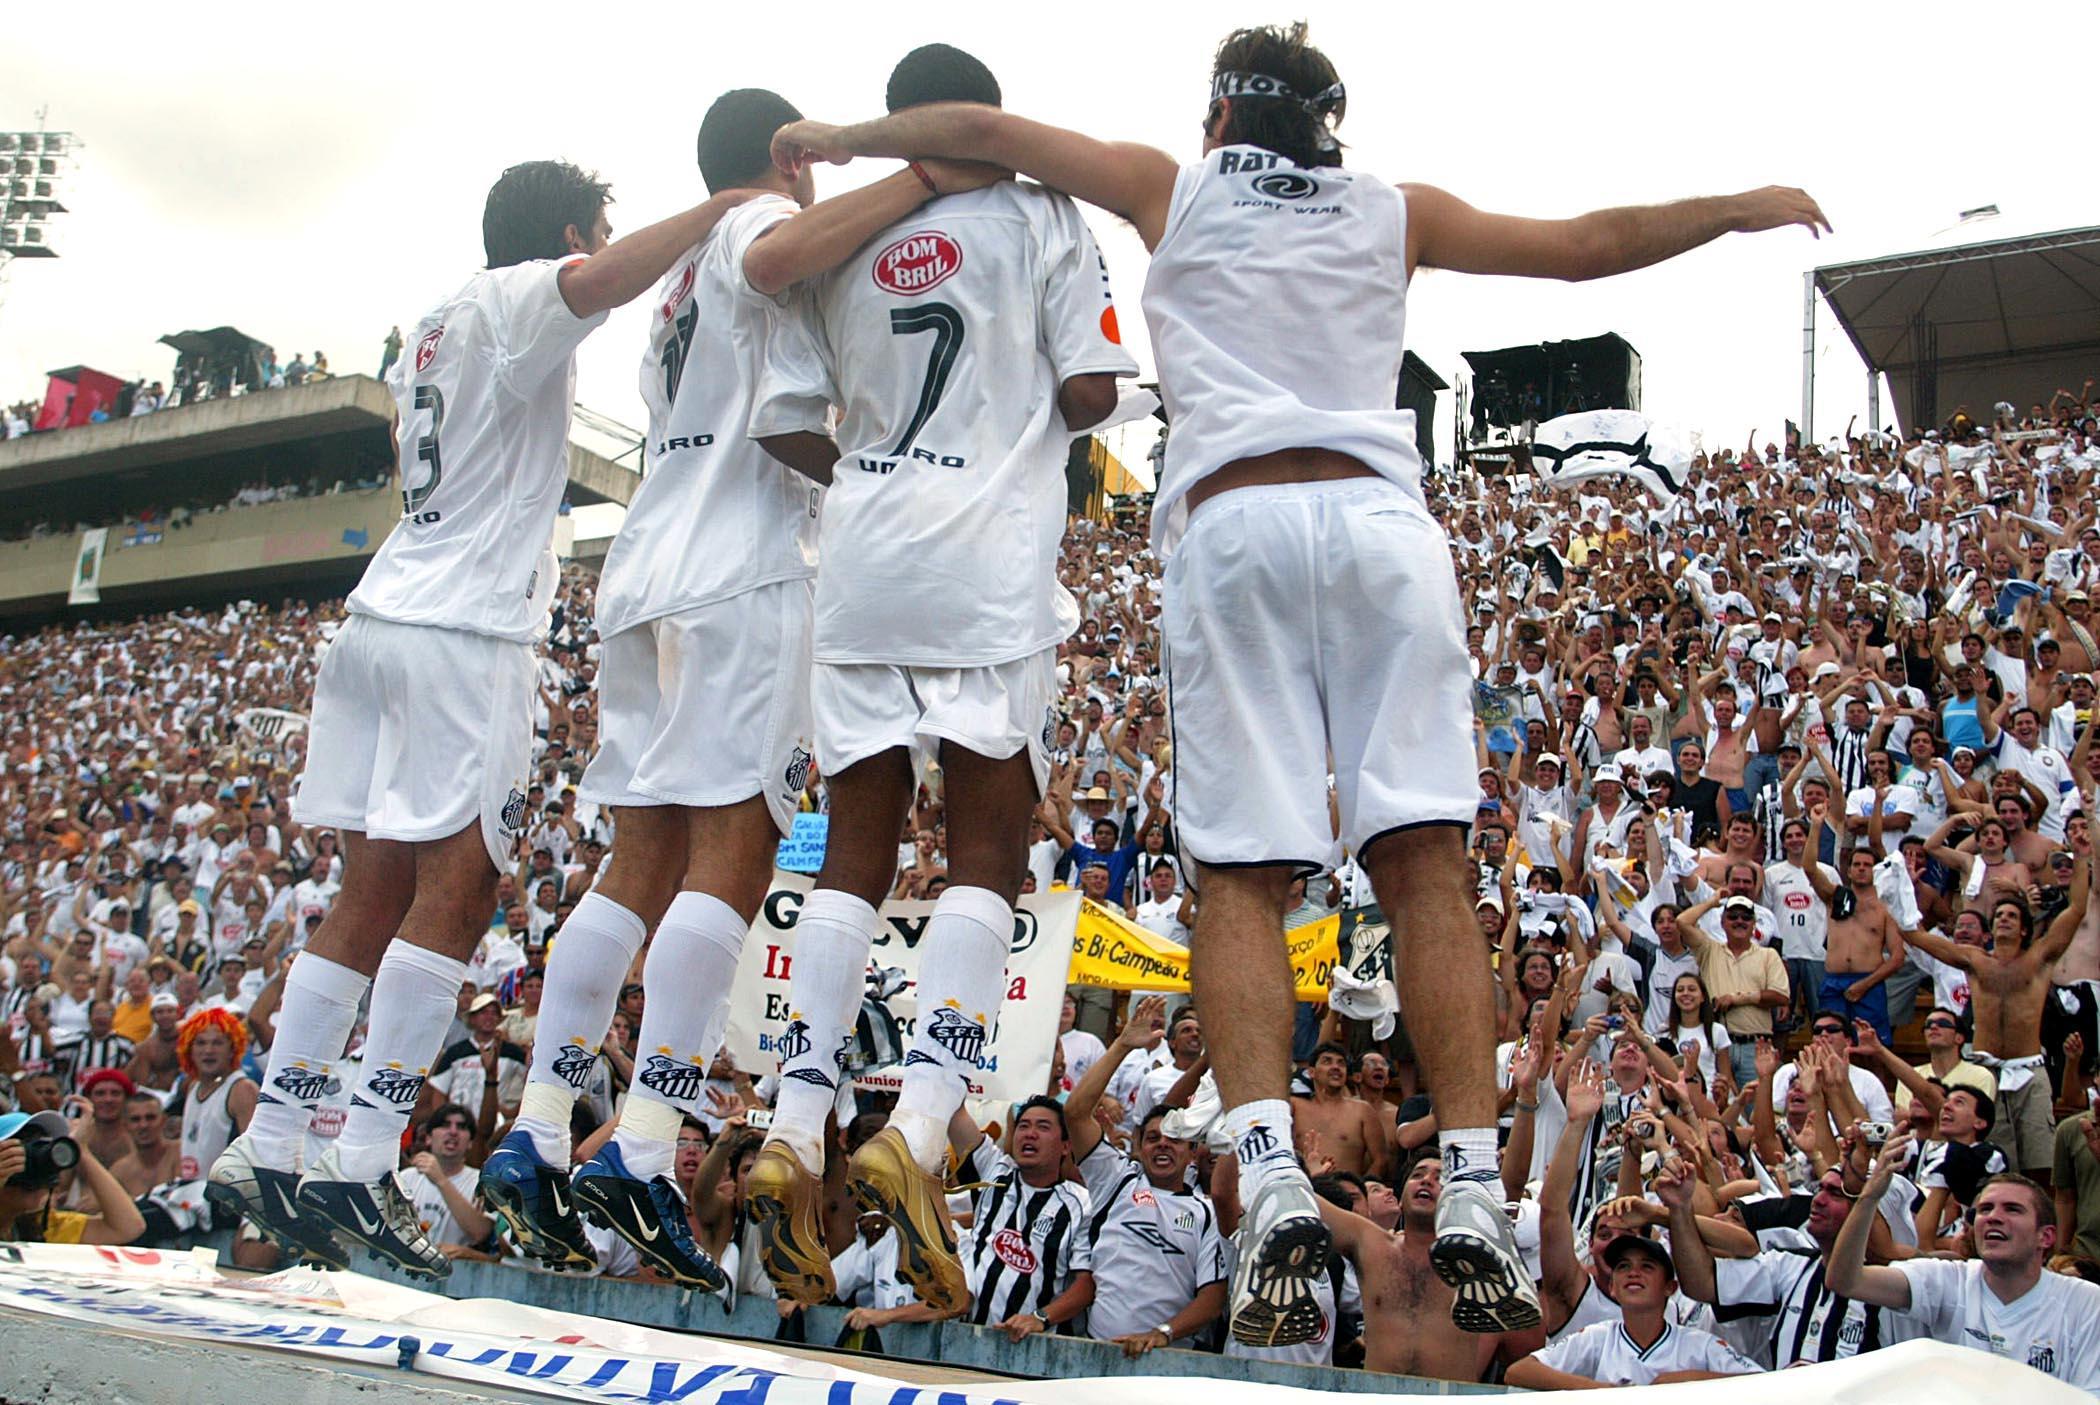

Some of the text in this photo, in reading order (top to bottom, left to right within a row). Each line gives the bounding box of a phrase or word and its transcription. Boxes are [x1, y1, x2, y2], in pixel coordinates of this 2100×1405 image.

[1232, 200, 1343, 215] SPORT WEAR
[887, 238, 938, 271] BOM
[893, 256, 948, 287] BRIL
[890, 301, 965, 457] 7
[1791, 913, 1805, 927] 10
[585, 1180, 608, 1200] ZOOM
